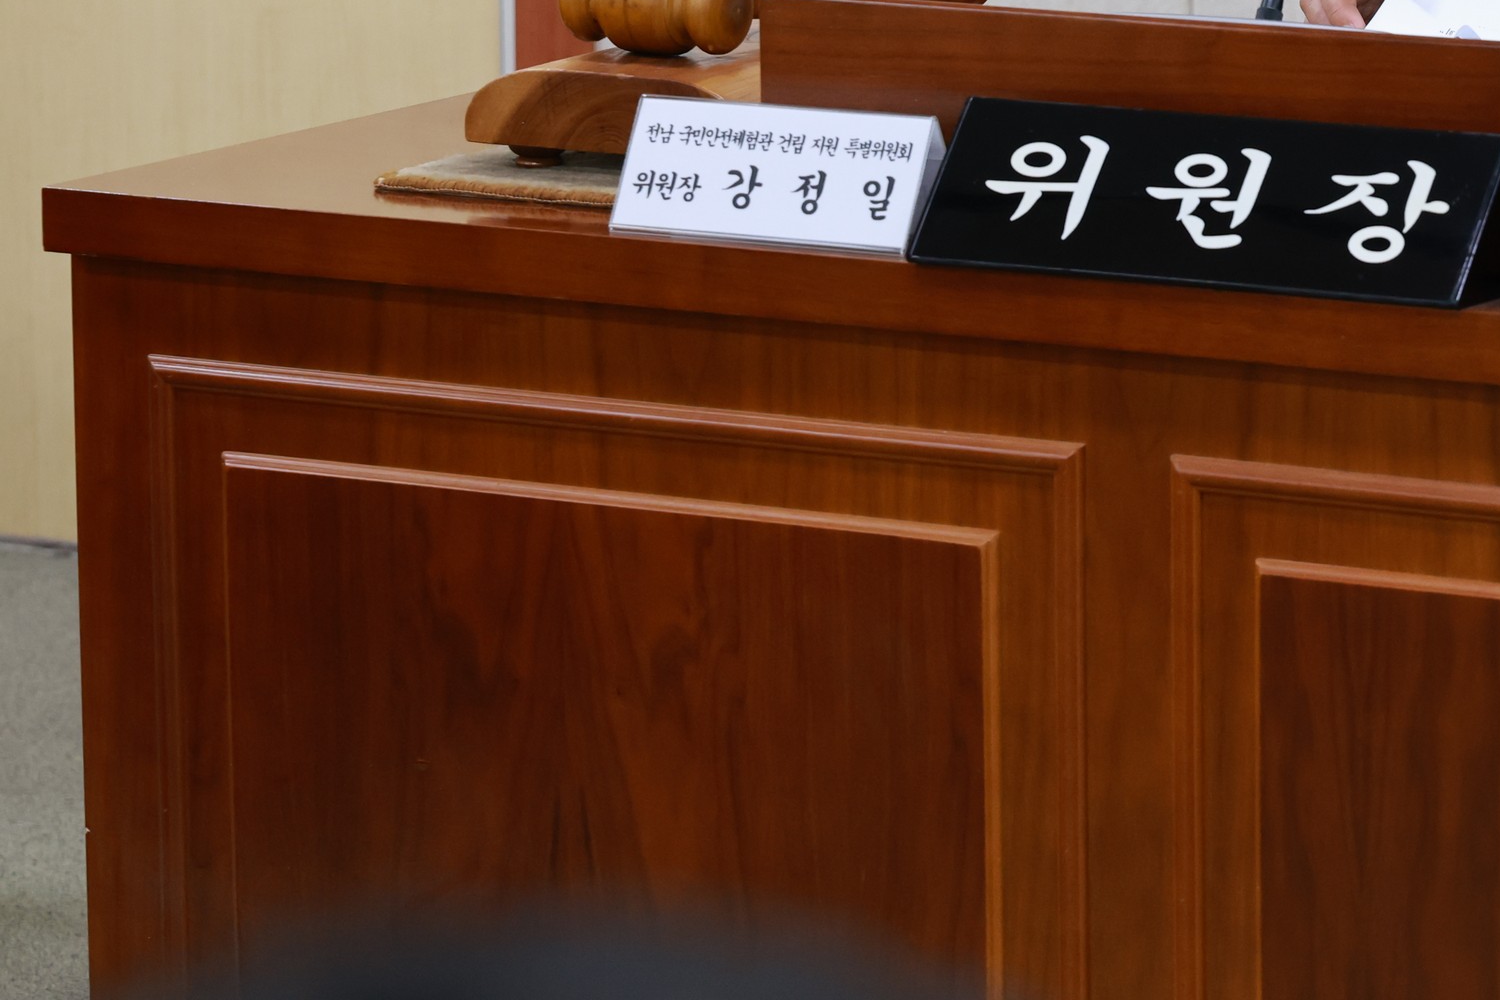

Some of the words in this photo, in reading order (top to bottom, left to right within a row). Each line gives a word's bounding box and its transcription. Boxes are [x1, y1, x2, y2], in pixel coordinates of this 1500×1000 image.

[646, 122, 675, 144] 전남
[679, 125, 774, 152] 국민안전체험관
[778, 132, 806, 155] 건립
[811, 135, 840, 158] 지원
[844, 138, 914, 163] 특별위원회
[632, 169, 702, 203] 위원장
